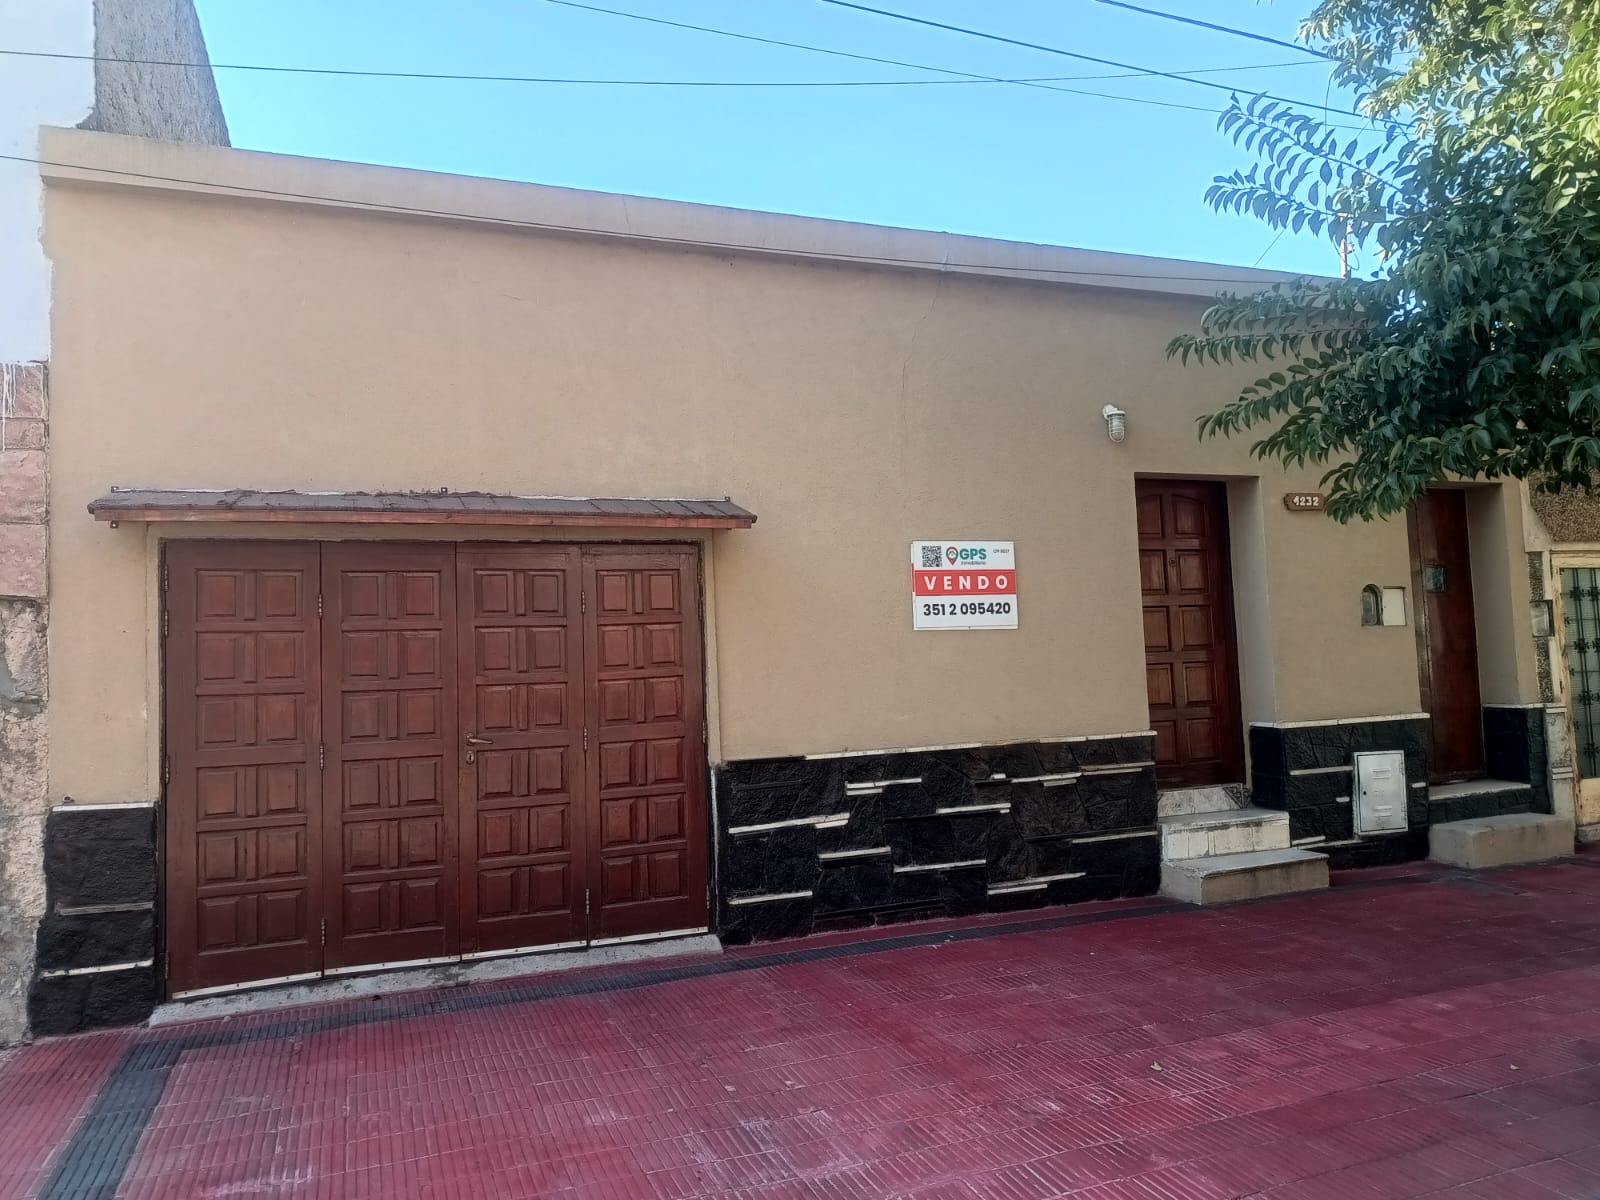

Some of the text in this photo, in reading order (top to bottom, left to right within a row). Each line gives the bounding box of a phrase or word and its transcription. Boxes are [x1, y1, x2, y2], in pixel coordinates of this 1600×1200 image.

[960, 548, 987, 560] GPS
[924, 575, 1008, 590] VENDO
[960, 602, 1011, 615] 095420
